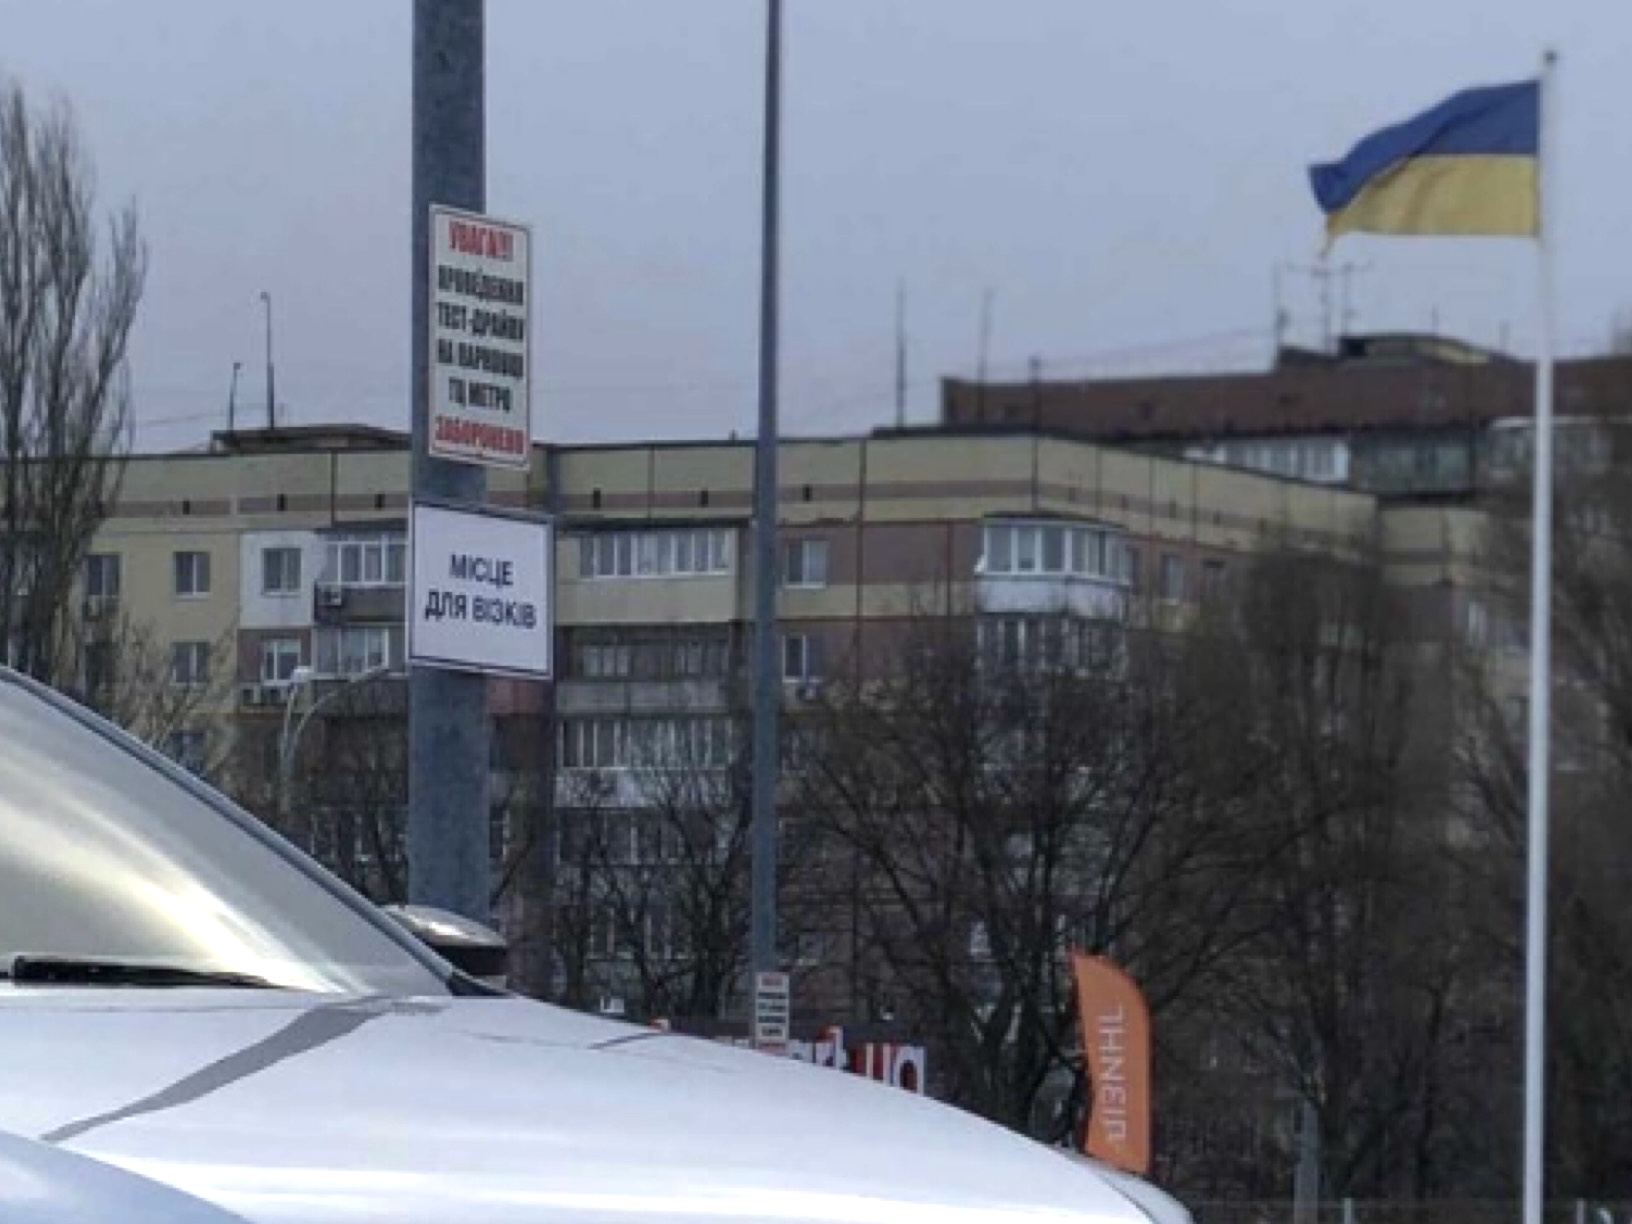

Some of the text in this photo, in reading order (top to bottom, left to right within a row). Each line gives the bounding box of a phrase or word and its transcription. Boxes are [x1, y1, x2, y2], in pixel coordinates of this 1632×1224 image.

[451, 554, 514, 588] МІСЦЕ
[425, 590, 537, 629] ДЛЯ ВІЗКІВ
